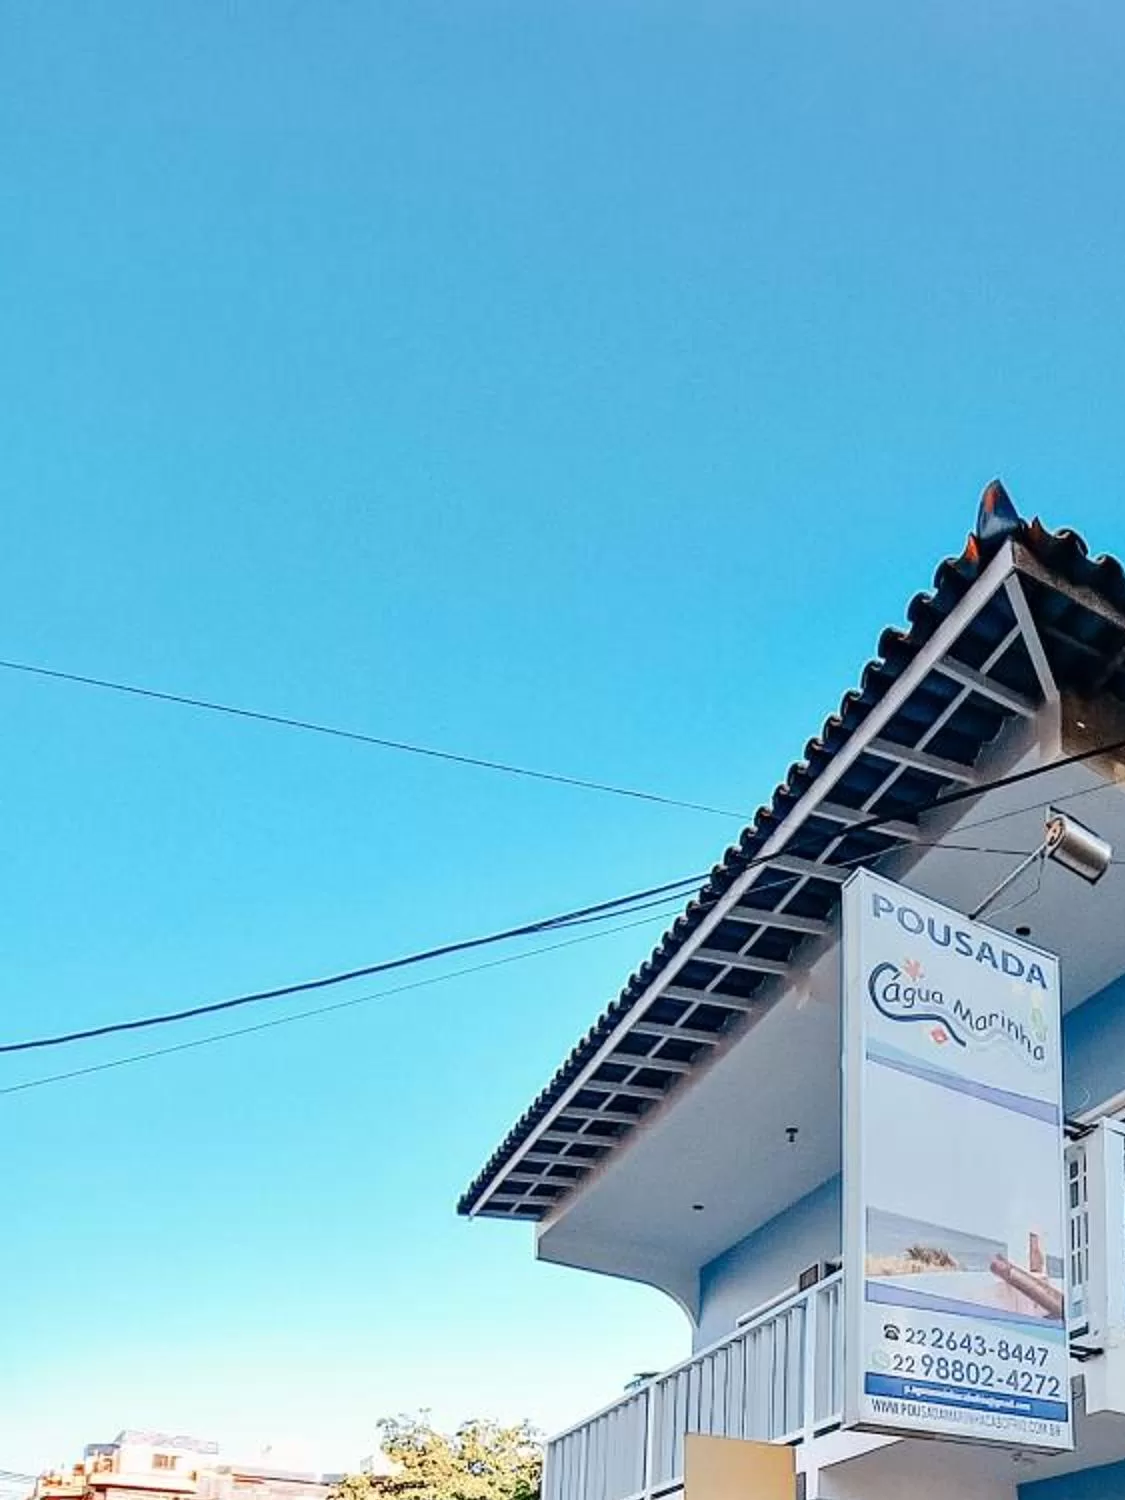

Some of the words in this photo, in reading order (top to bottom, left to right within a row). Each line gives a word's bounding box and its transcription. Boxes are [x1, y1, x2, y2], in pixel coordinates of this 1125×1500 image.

[872, 893, 1047, 990] POUSADA
[905, 1327, 926, 1346] 22
[931, 1328, 1049, 1367] 2643-8447
[892, 1354, 916, 1374] 22
[921, 1354, 1061, 1397] 98802-4272
